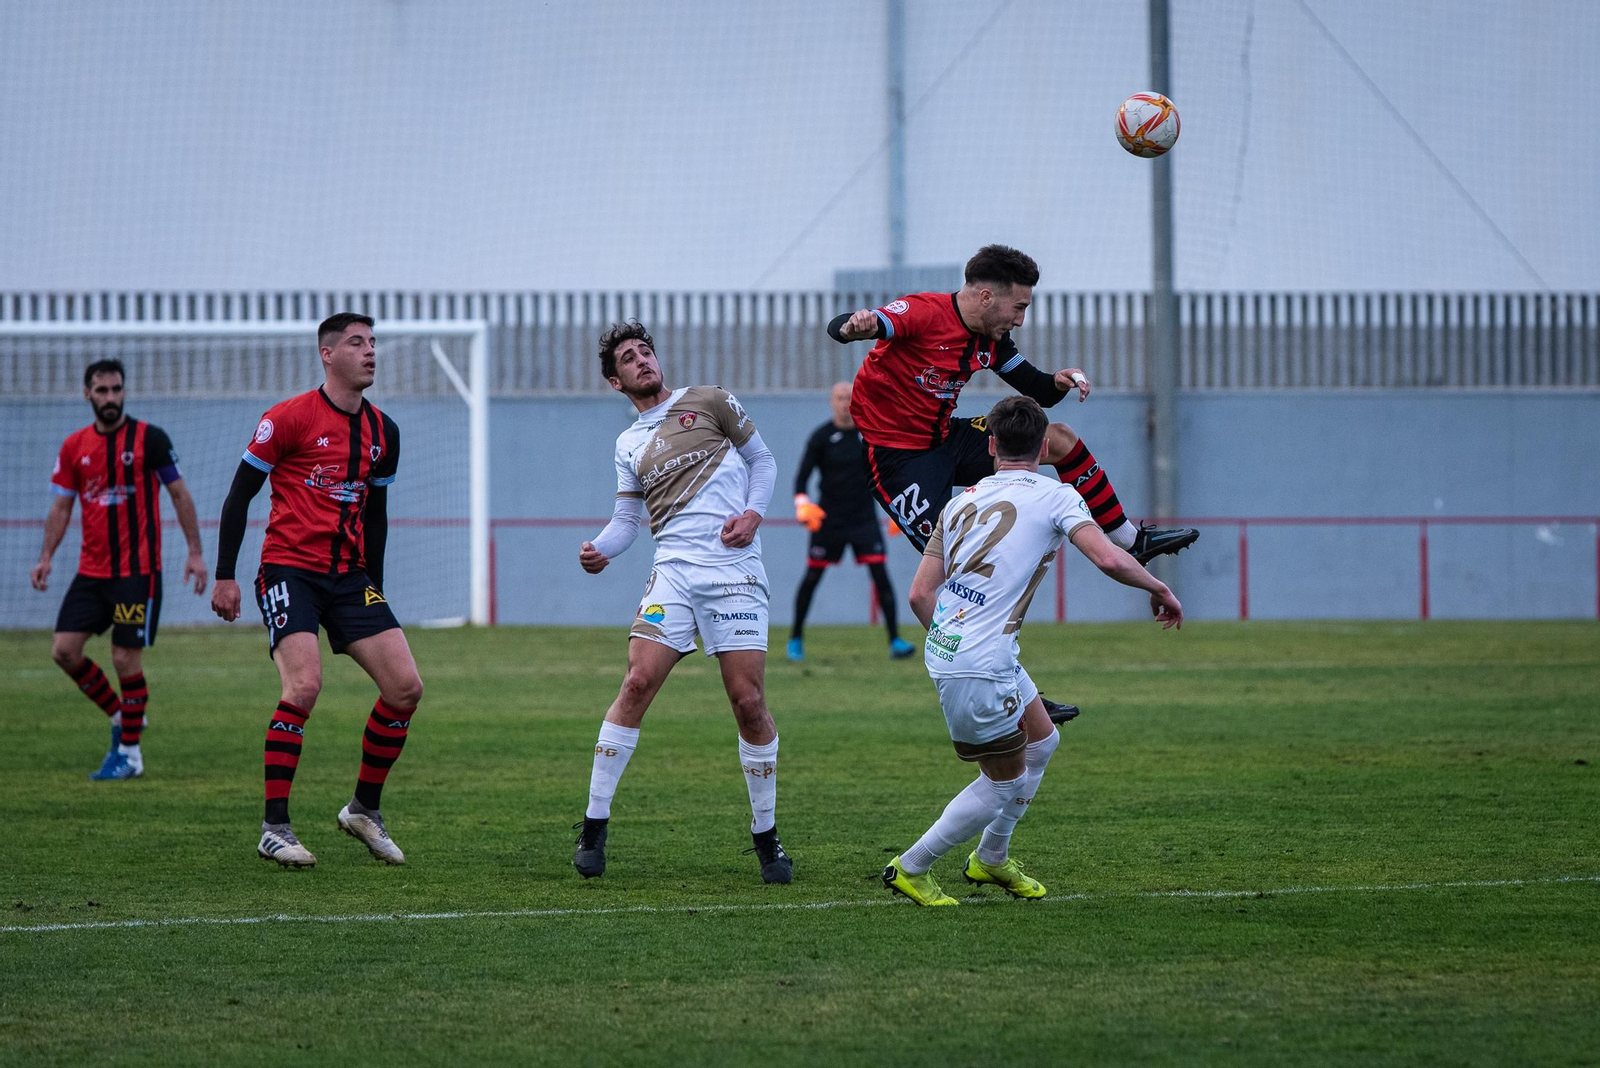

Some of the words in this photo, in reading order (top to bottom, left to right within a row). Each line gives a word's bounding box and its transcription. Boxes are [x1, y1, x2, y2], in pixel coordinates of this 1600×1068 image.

[892, 483, 930, 525] 22
[946, 500, 1017, 580] 22
[268, 581, 290, 612] 14
[114, 604, 145, 622] AVS
[720, 612, 759, 622] TAMESUR
